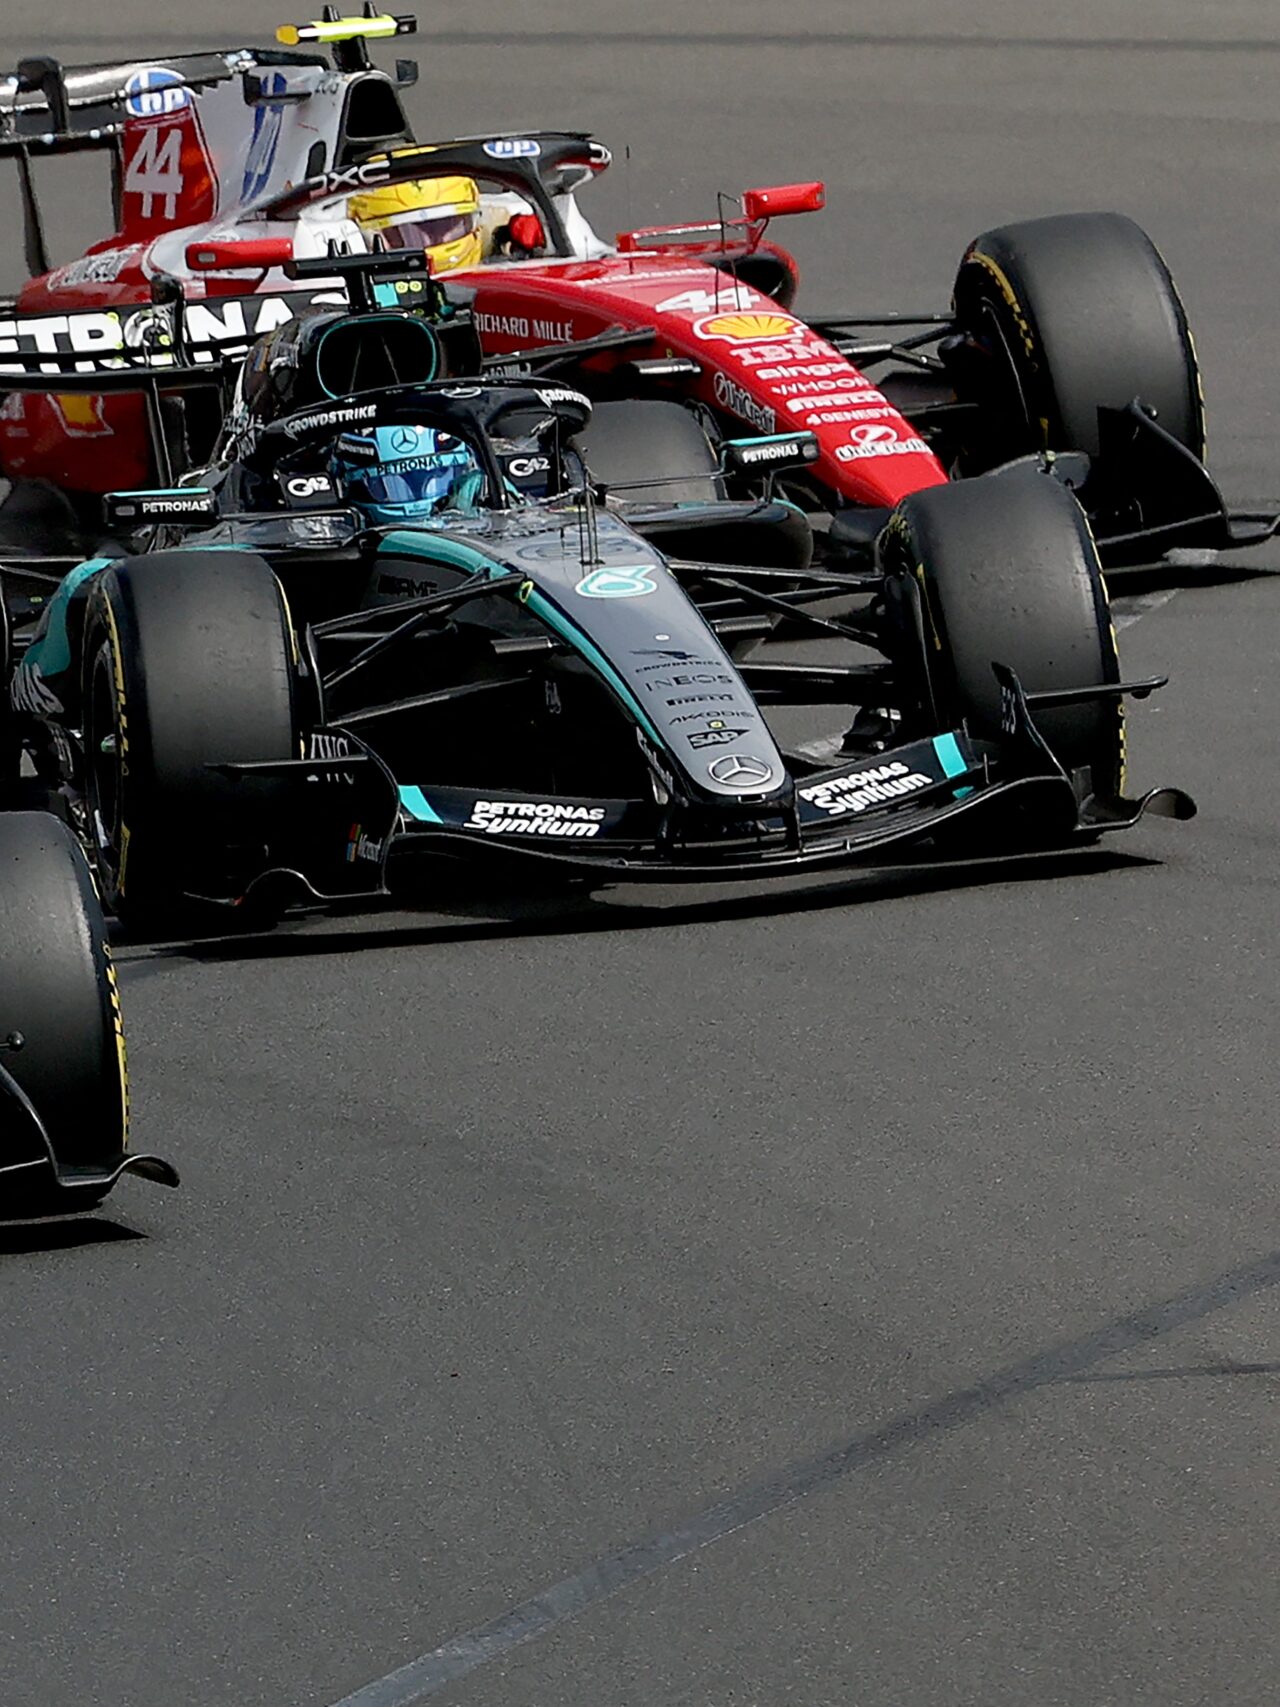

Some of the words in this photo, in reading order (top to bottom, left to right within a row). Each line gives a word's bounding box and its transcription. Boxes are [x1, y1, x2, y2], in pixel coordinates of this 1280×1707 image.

[124, 127, 184, 220] 44
[655, 286, 762, 314] 44
[474, 312, 529, 338] RICHARD
[532, 319, 573, 344] MILLE
[729, 340, 840, 367] IBM
[283, 403, 378, 441] CROWDSTRIKE
[376, 455, 444, 475] PETRONAS
[741, 443, 799, 464] PETRONAS
[141, 500, 211, 513] PETRONAS
[645, 674, 734, 692] INEOS
[688, 731, 739, 748] SAP
[799, 762, 909, 801] PETRONAS
[814, 773, 933, 815] Syntium
[474, 801, 605, 820] PETRONAS
[464, 813, 600, 837] Syntium
